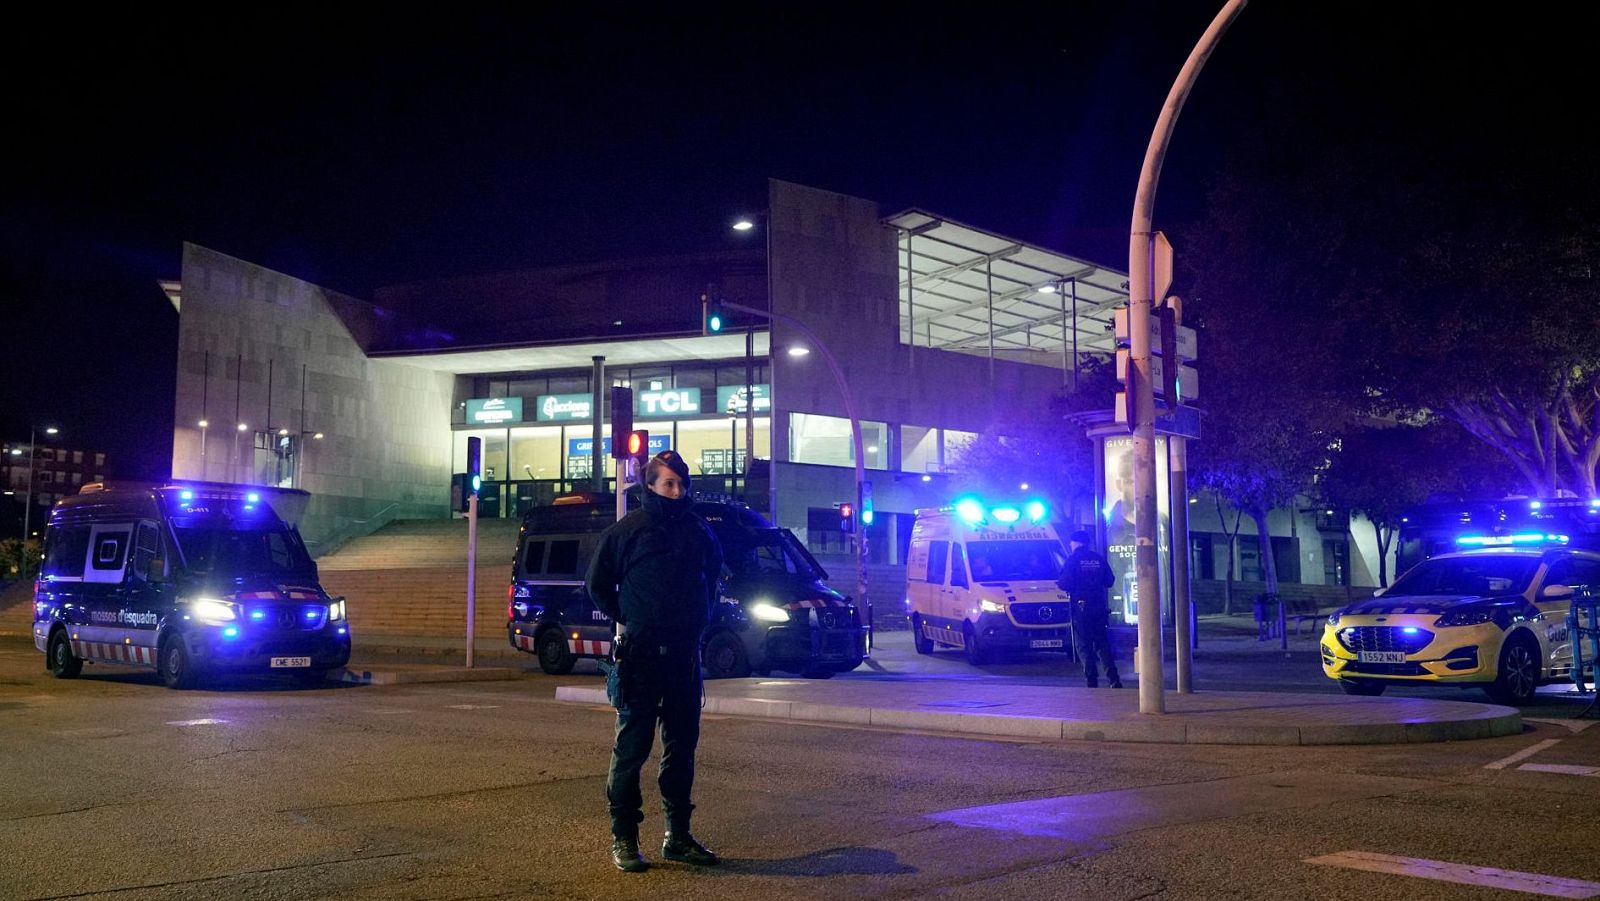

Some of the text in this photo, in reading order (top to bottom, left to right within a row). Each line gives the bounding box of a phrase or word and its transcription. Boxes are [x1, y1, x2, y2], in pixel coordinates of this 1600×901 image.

[641, 391, 698, 413] TCL
[91, 609, 157, 627] mossos d'esquadra
[291, 658, 307, 666] 5521
[1364, 653, 1384, 662] 1552
